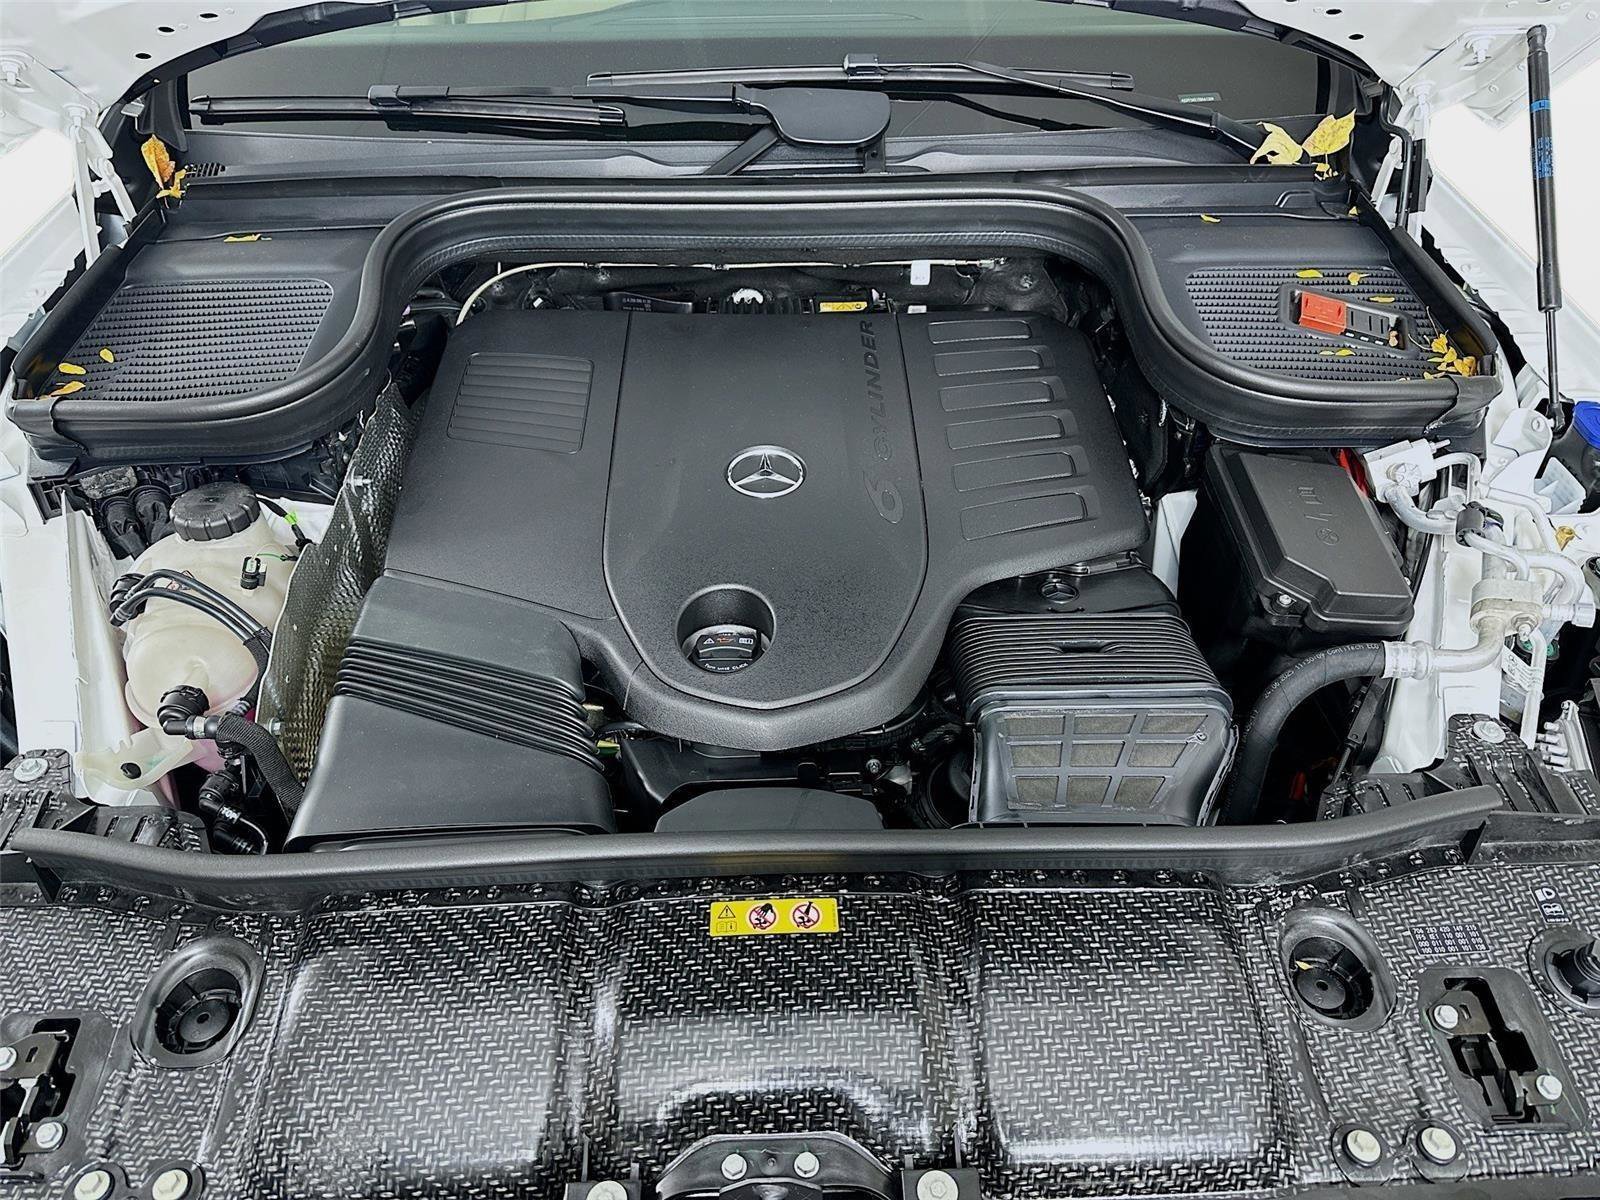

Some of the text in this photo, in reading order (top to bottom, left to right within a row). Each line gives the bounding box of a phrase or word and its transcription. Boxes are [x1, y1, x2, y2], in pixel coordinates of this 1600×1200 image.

[860, 320, 904, 524] 6 CYLINDER
[1326, 643, 1364, 656] ContiTech
[732, 662, 748, 670] CLICK
